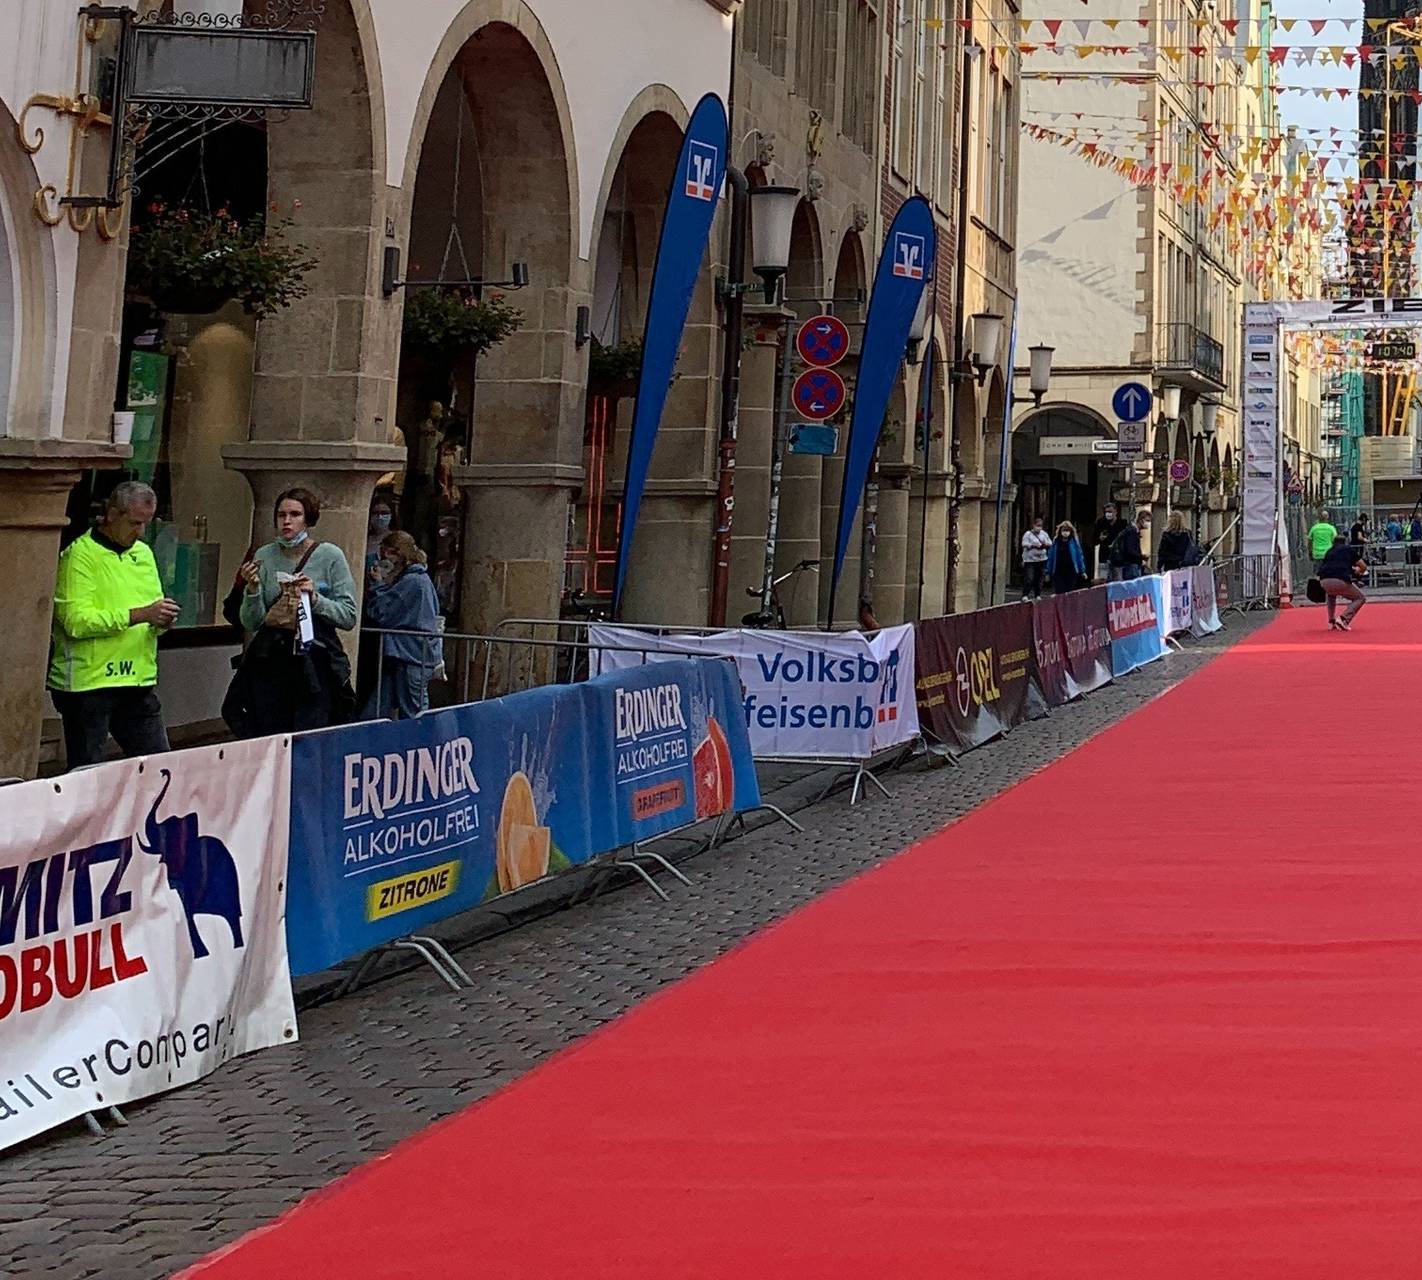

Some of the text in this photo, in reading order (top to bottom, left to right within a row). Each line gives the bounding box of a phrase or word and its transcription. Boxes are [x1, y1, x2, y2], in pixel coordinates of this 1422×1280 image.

[105, 660, 136, 677] S.W.
[757, 651, 880, 683] Volksb
[615, 683, 687, 741] ERDINGER
[617, 738, 688, 775] ALKOHOLFREI
[344, 736, 480, 819] ERDINGER
[344, 804, 479, 865] ALKOHOLFREI
[379, 868, 450, 909] ZITRONE
